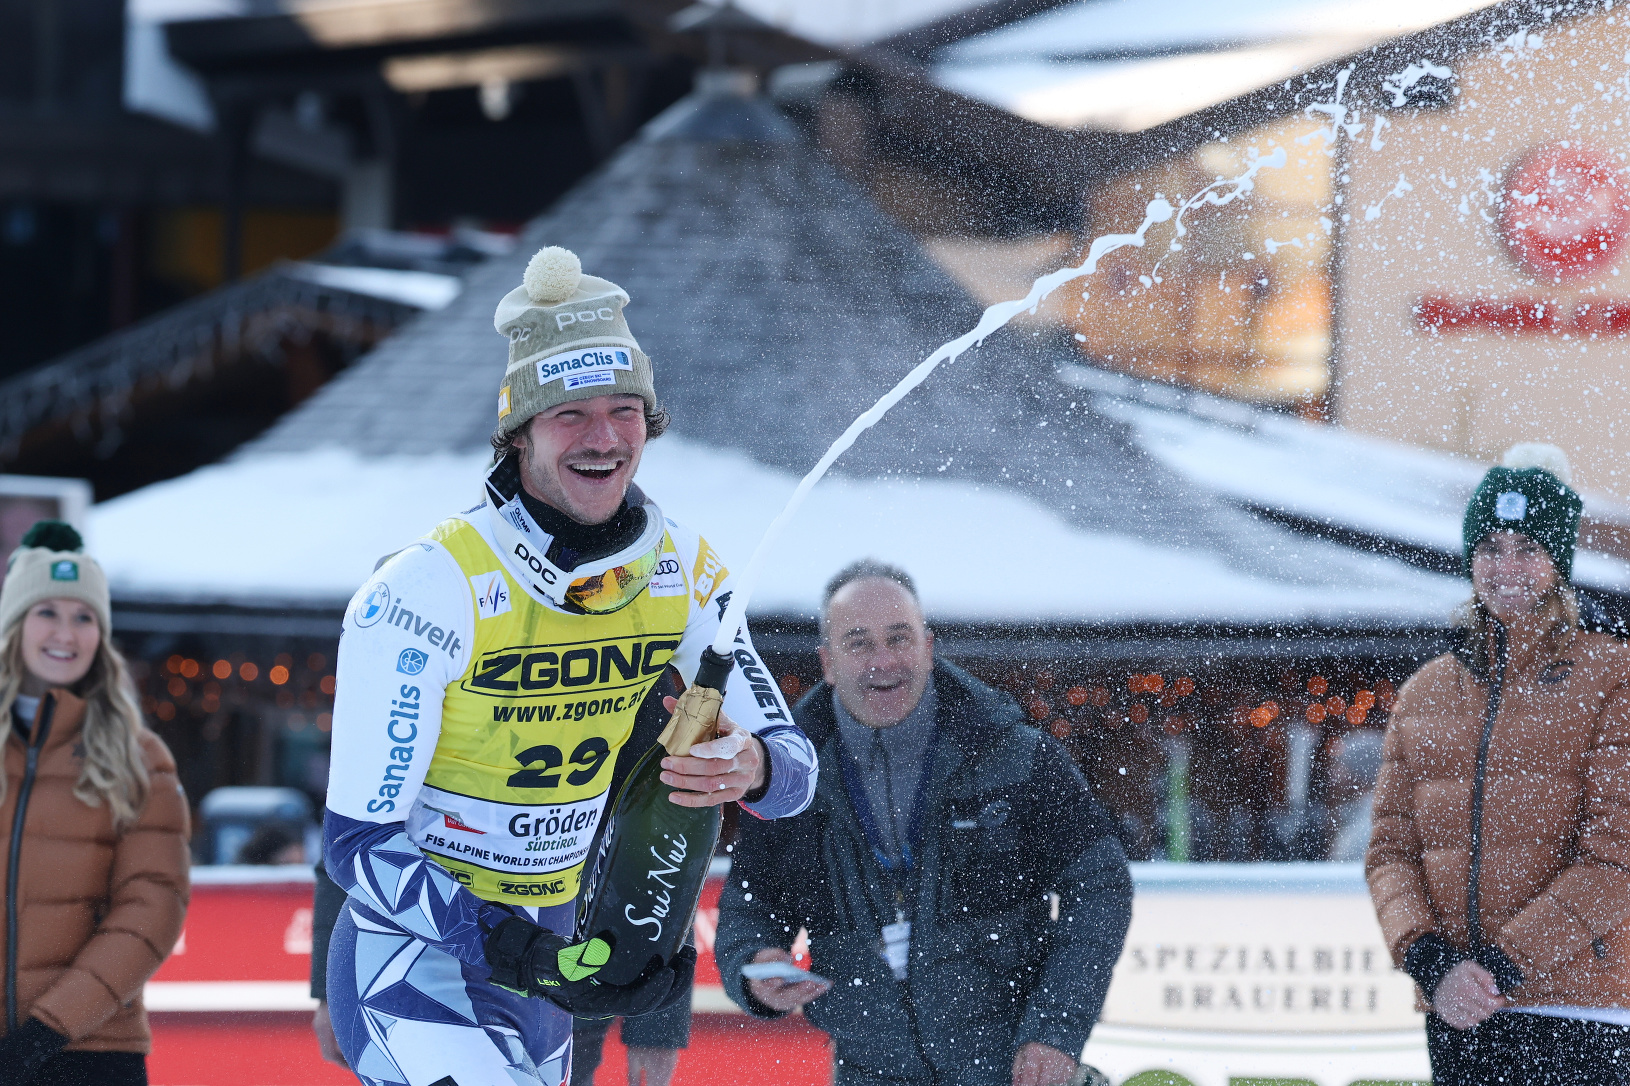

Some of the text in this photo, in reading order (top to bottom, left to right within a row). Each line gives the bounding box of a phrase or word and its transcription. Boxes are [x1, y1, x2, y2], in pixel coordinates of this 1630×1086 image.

[541, 352, 614, 379] SanaClis
[515, 508, 530, 533] OLYMP
[387, 598, 461, 659] invelt
[471, 640, 679, 691] ZGONC
[366, 684, 421, 814] SanaClis
[506, 736, 611, 788] 29
[508, 808, 597, 837] Gröden
[425, 834, 445, 847] FIS
[447, 841, 490, 860] ALPINE
[493, 853, 531, 867] WORLD
[532, 858, 546, 866] SKI
[501, 880, 565, 895] ZGONC
[625, 834, 688, 942] Sui Nui
[1129, 944, 1380, 974] SPEZIALBIE
[537, 977, 561, 987] LEKI
[1162, 983, 1378, 1011] BRAUEREI
